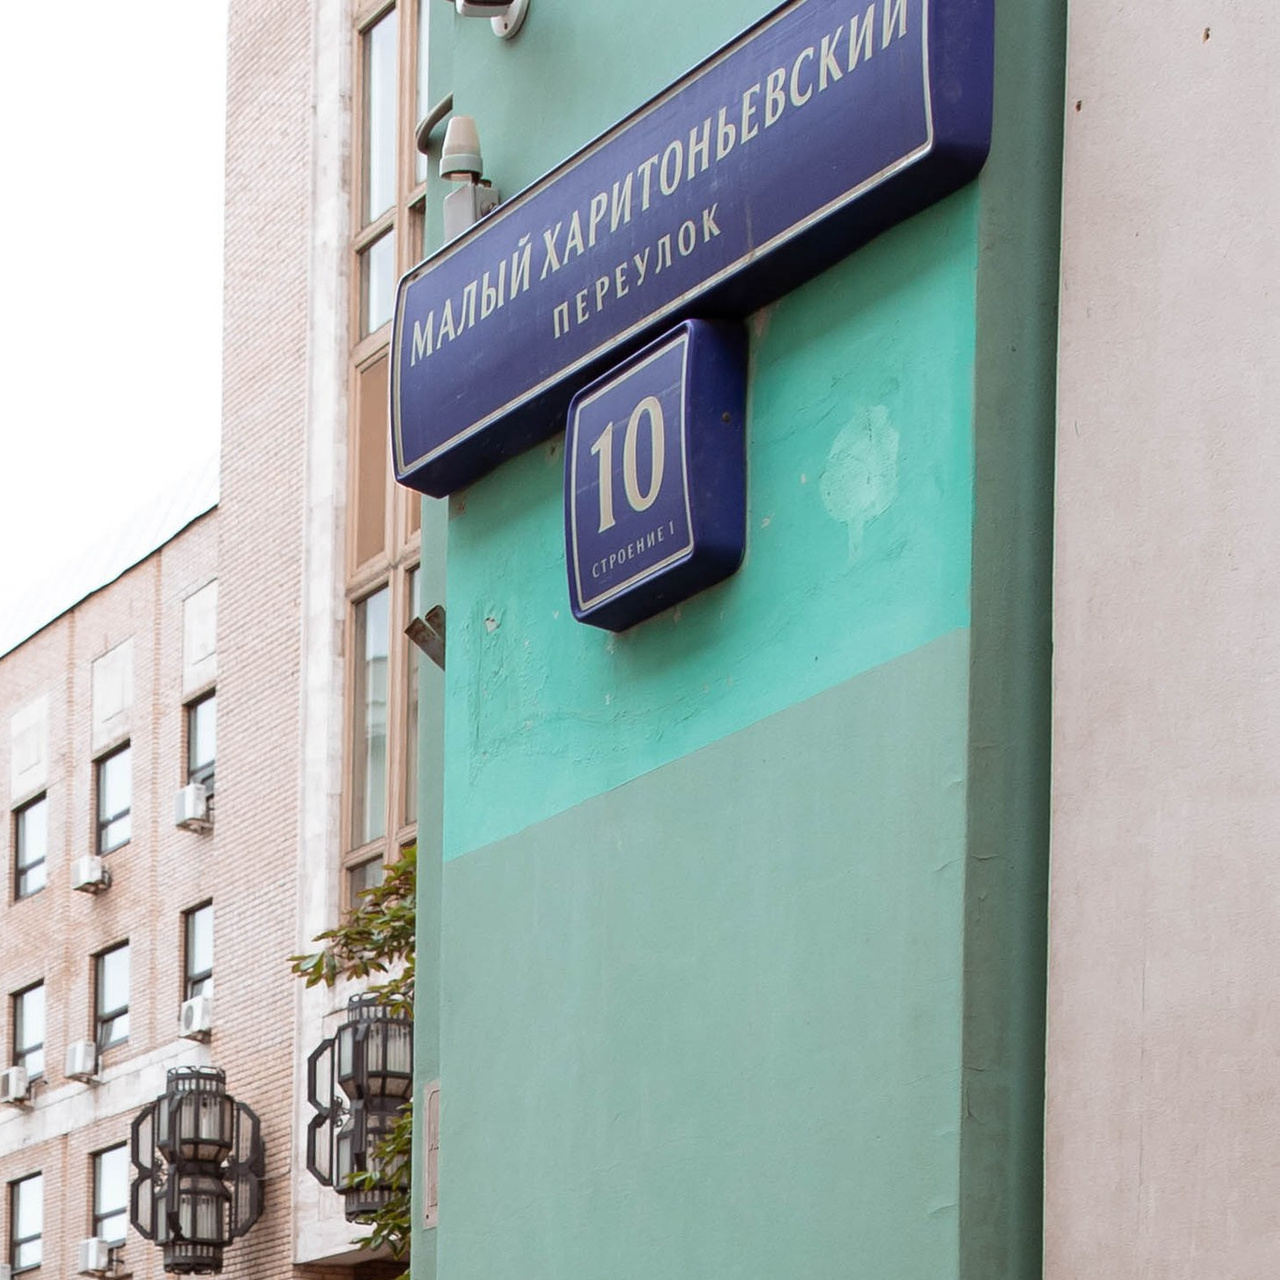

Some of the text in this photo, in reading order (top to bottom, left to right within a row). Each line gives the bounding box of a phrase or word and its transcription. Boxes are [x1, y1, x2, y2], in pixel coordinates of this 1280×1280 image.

[410, 232, 533, 368] МАЛЫЙ
[552, 202, 721, 340] ПЕРЕУЛОК
[590, 395, 666, 535] 10
[591, 520, 675, 579] СТРОЕНИЕ 1
